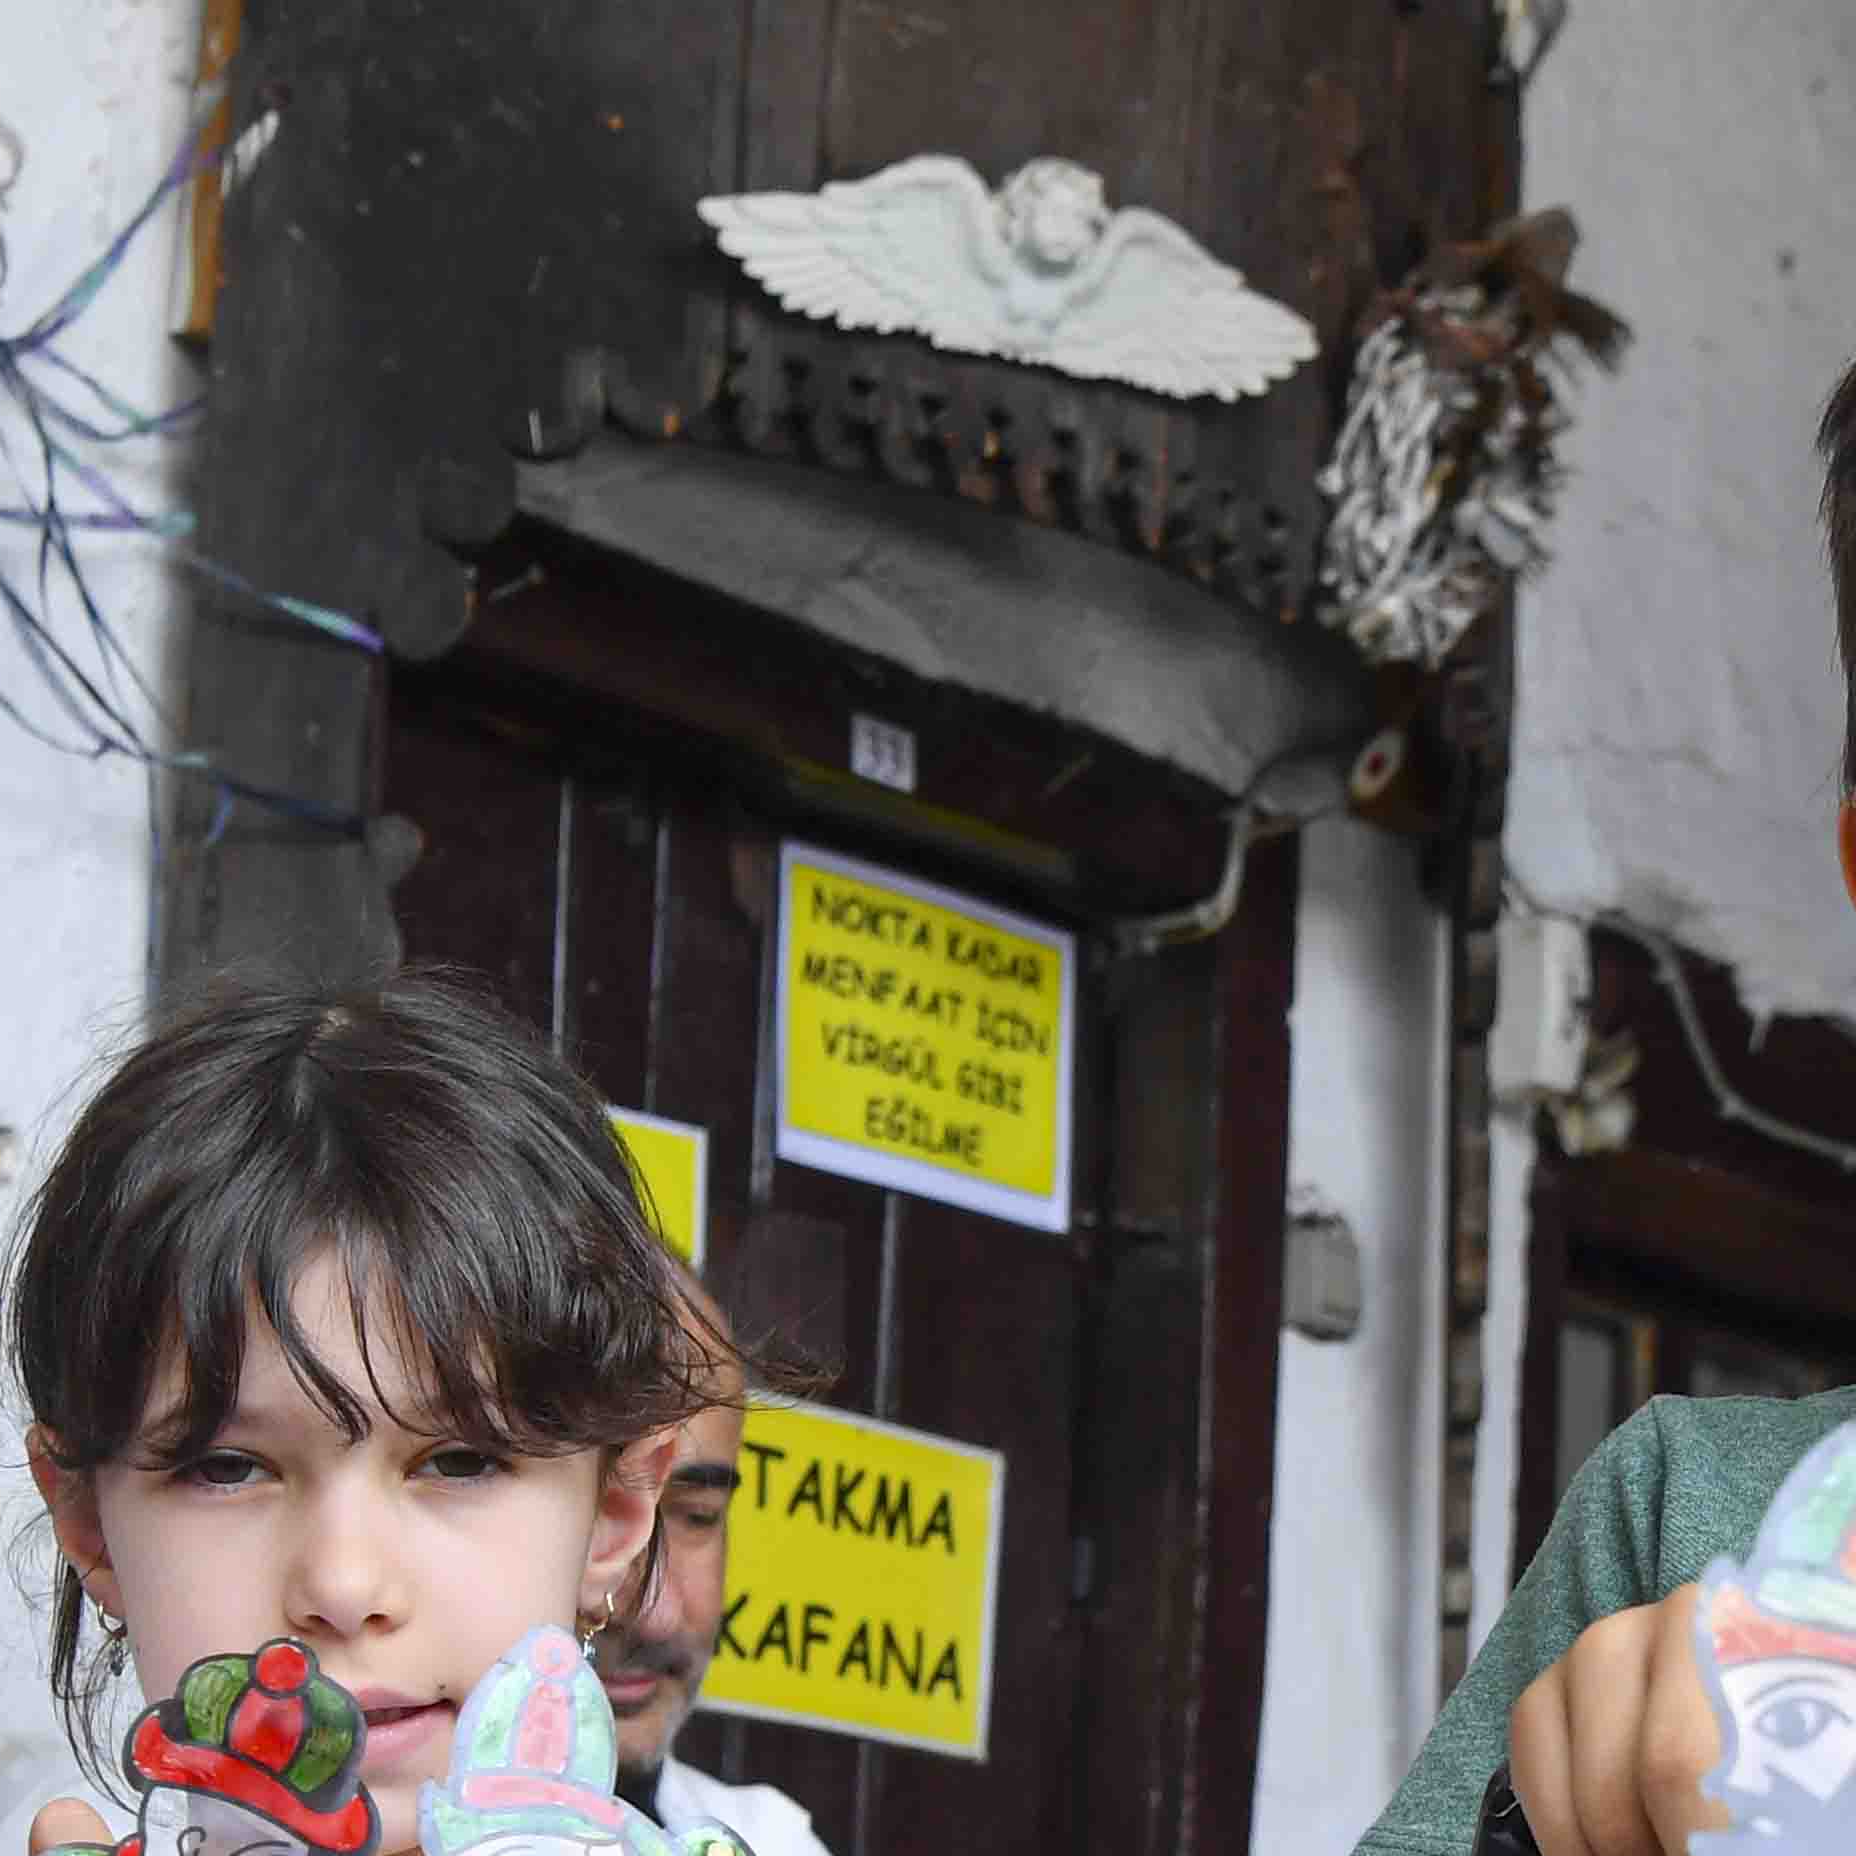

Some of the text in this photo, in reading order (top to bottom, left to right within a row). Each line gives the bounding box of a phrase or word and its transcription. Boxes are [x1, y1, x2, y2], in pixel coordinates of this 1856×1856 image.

[810, 883, 1042, 992] NOKTA KADAR
[801, 948, 1052, 1057] MENFAAT İÇİN
[821, 1018, 1025, 1116] VİRGÜL GİBİ
[863, 1095, 984, 1168] EĞİLME
[743, 1441, 956, 1557] TAKMA
[713, 1591, 964, 1703] KAFANA
